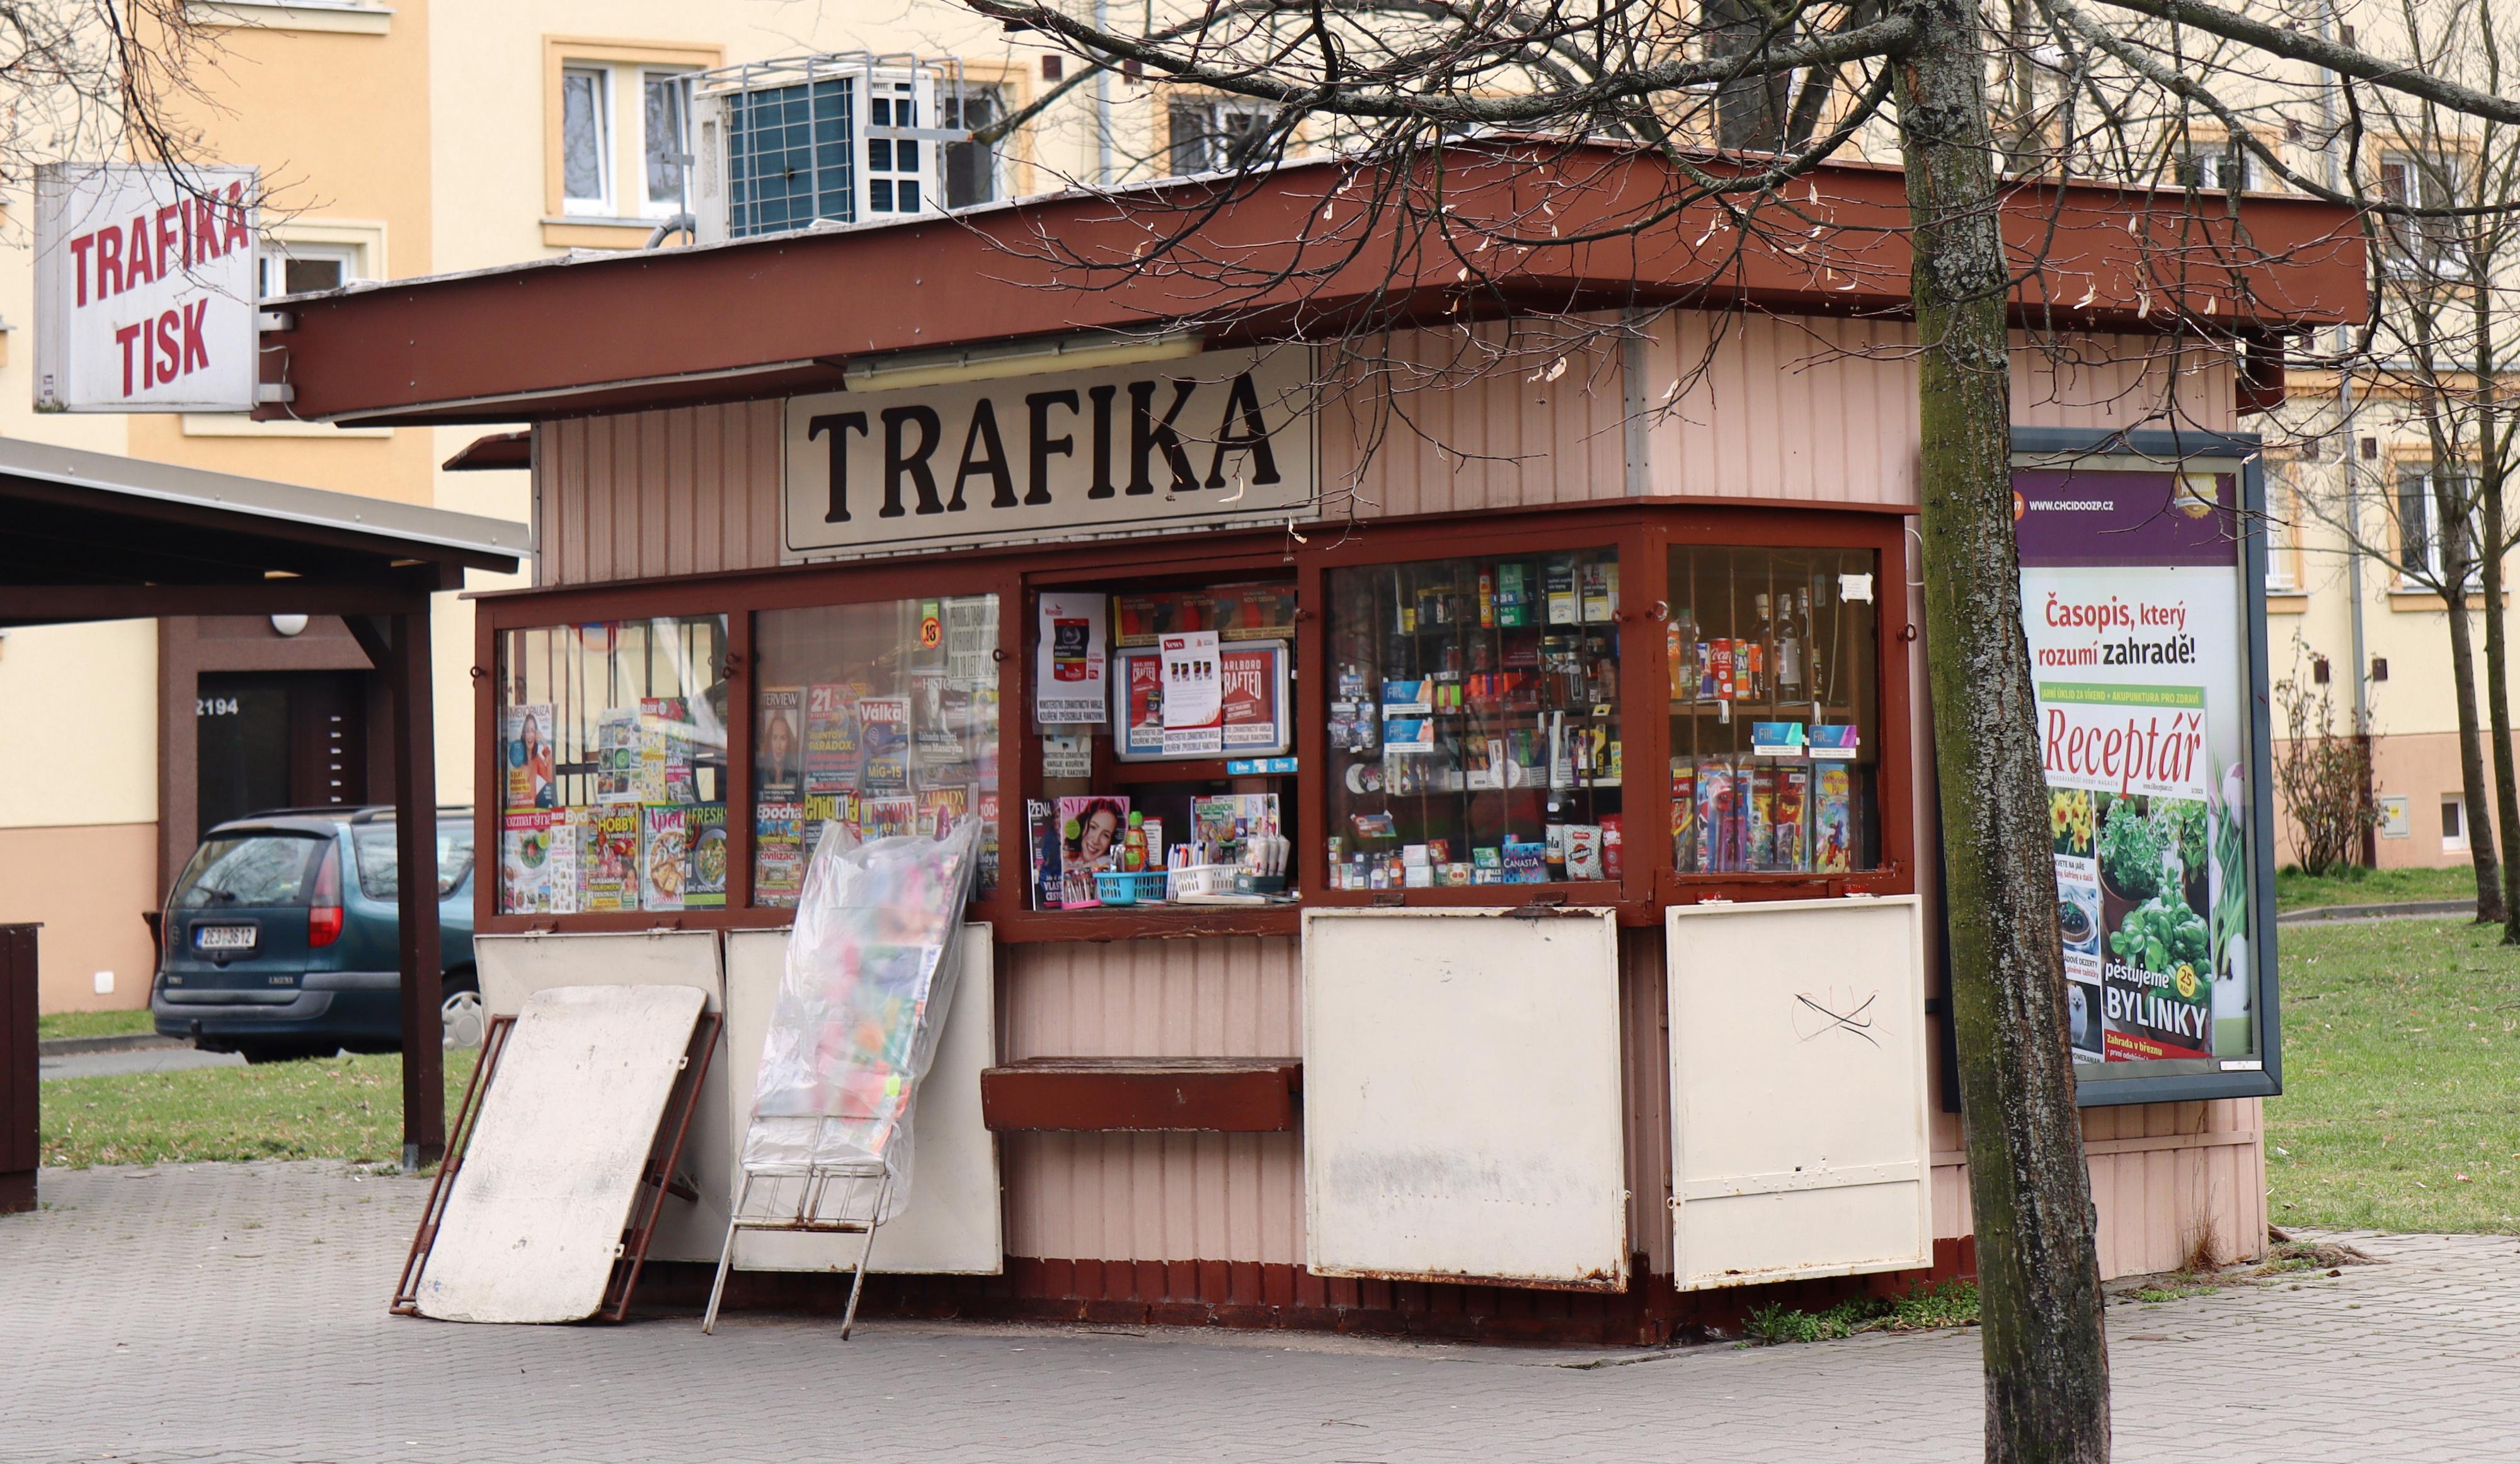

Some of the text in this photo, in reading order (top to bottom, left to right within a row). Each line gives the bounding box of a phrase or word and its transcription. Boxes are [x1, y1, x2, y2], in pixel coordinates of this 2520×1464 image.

[71, 180, 249, 308] TRAFIKA
[116, 298, 209, 398] TISK
[808, 370, 1281, 523] TRAFIKA
[2029, 501, 2114, 512] WWW.CHCIDOOZP.CZ
[2046, 592, 2186, 633] Časopis, který
[2039, 634, 2196, 666] rozumí zahradě!
[1221, 660, 1261, 671] ARLBORO
[1222, 671, 1261, 701] RAFTED
[196, 697, 239, 716] 2194
[2112, 691, 2160, 703] AKUPUNKTURA
[2161, 694, 2175, 704] PRO
[2176, 692, 2199, 704] ZDRAVÍ
[861, 702, 902, 721] Válka
[2044, 709, 2202, 799] Receptář
[757, 802, 802, 823] Epocha
[598, 817, 635, 832] HOBBY
[1503, 855, 1539, 868] CANASTA
[2105, 958, 2170, 989] pěstujeme
[2180, 968, 2192, 987] 25
[2106, 985, 2208, 1040] BYLINKY
[2107, 1034, 2163, 1056] Zahrada v březnu
